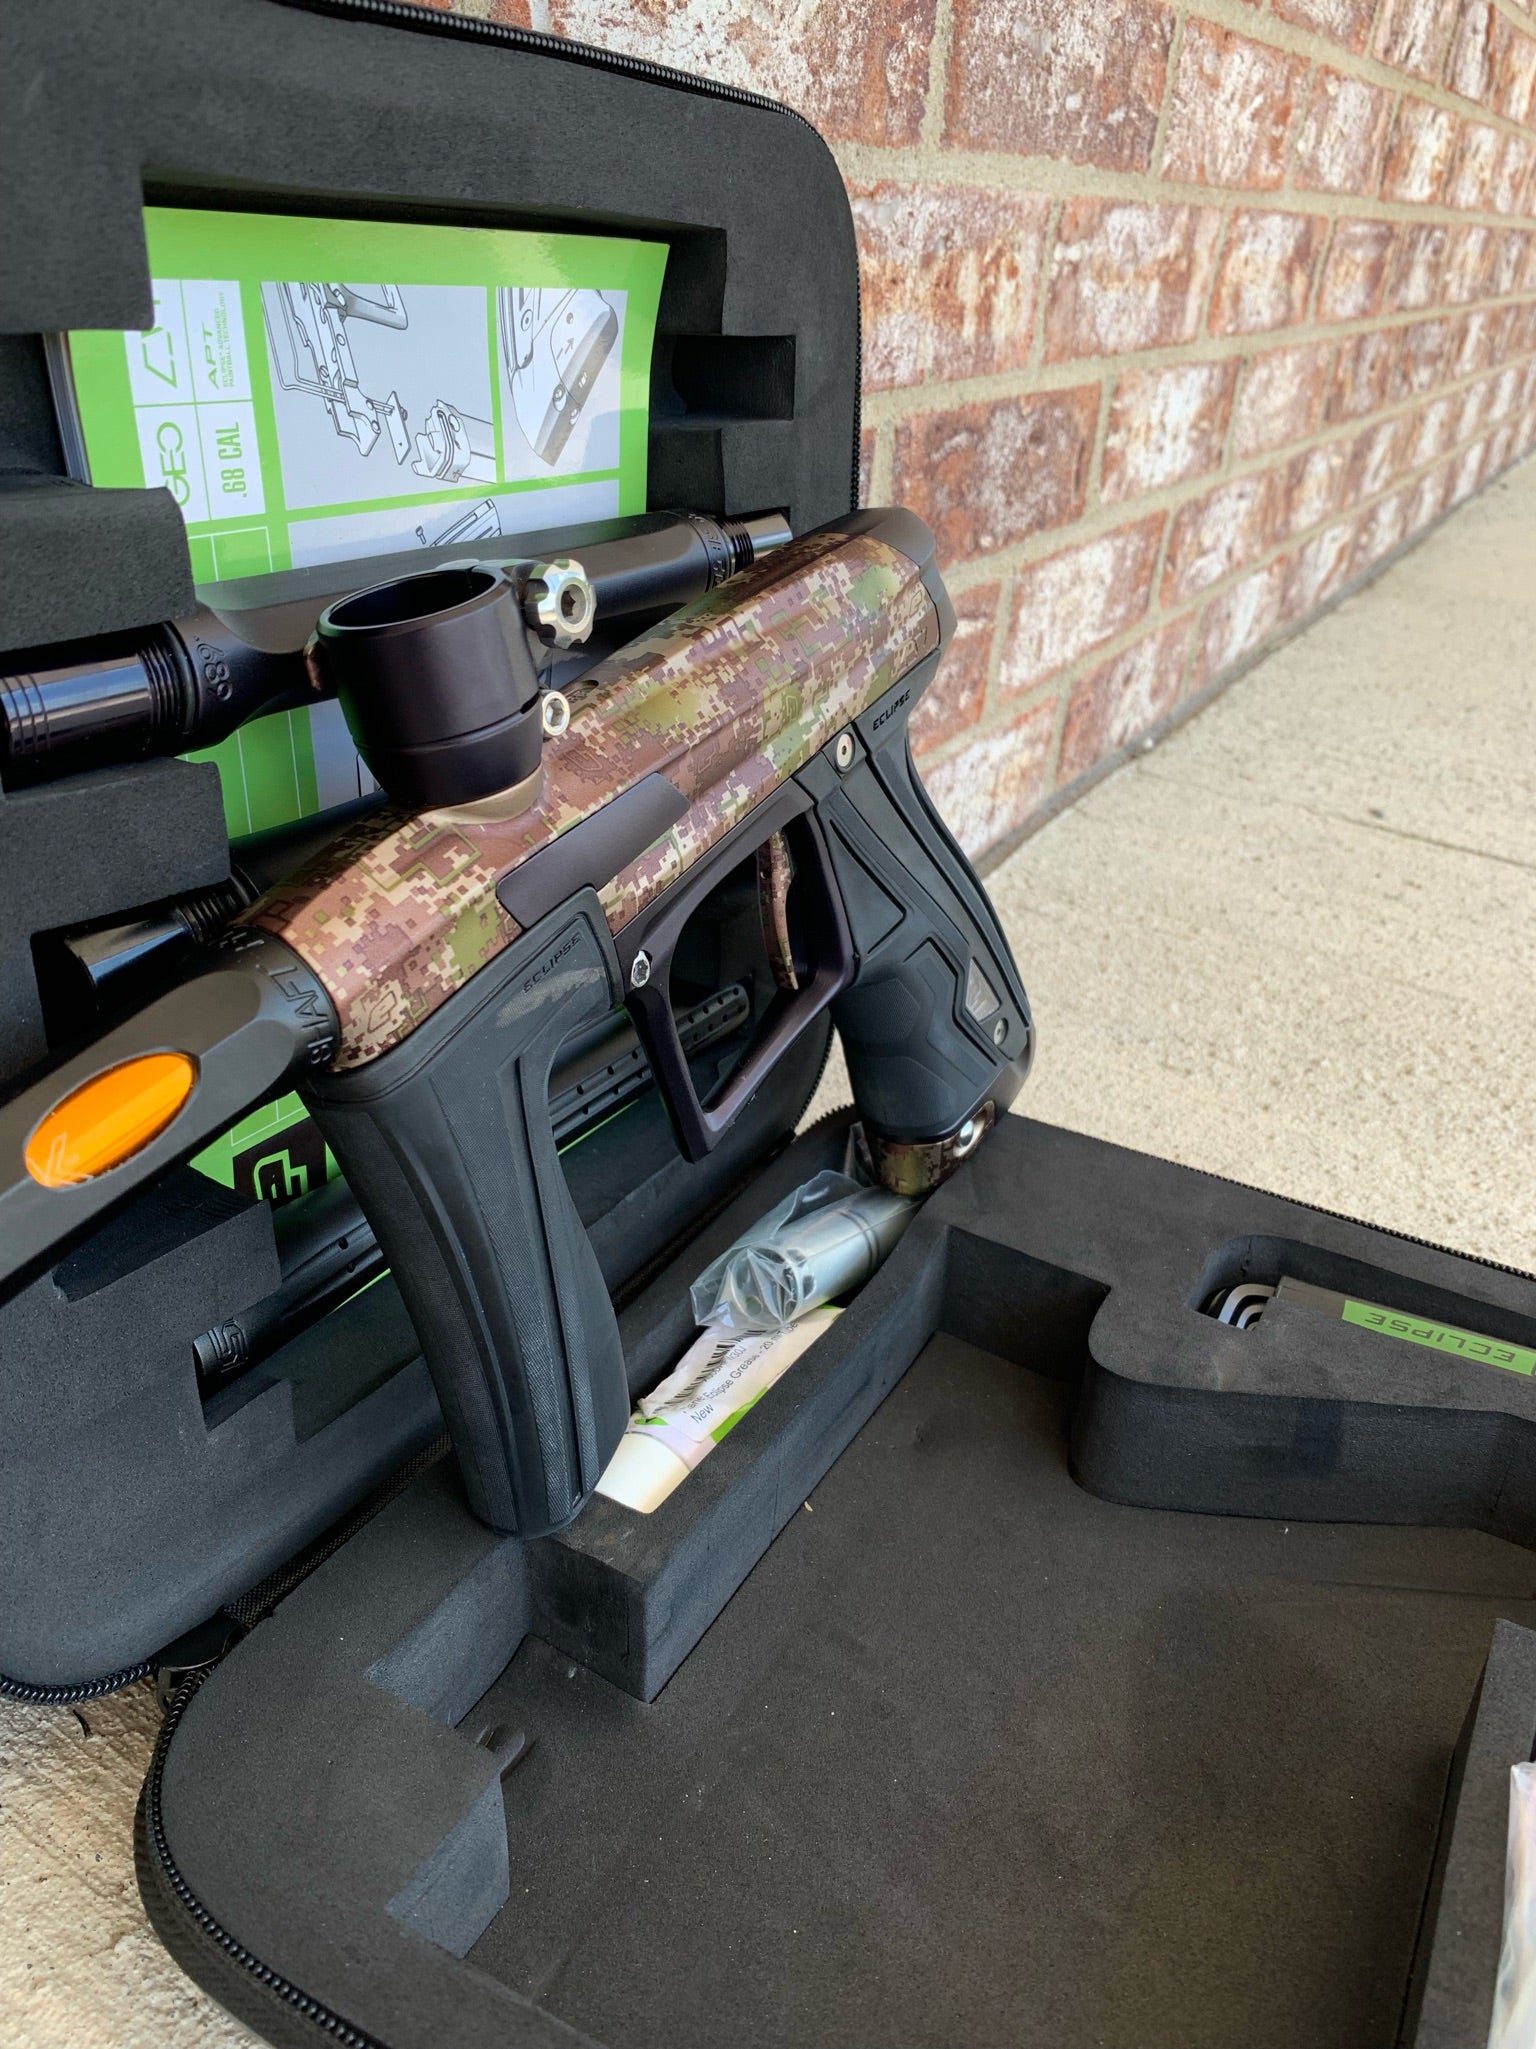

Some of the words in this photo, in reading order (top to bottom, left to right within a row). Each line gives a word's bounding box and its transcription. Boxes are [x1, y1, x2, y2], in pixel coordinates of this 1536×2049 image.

[202, 321, 218, 390] APT
[216, 422, 242, 460] CAL
[220, 468, 247, 497] .68
[873, 689, 910, 731] ECLIPSE
[523, 930, 581, 993] ECLIPSE
[1345, 1312, 1516, 1363] ECLIPSE
[703, 1379, 734, 1399] Eclipse
[690, 1404, 714, 1424] New
